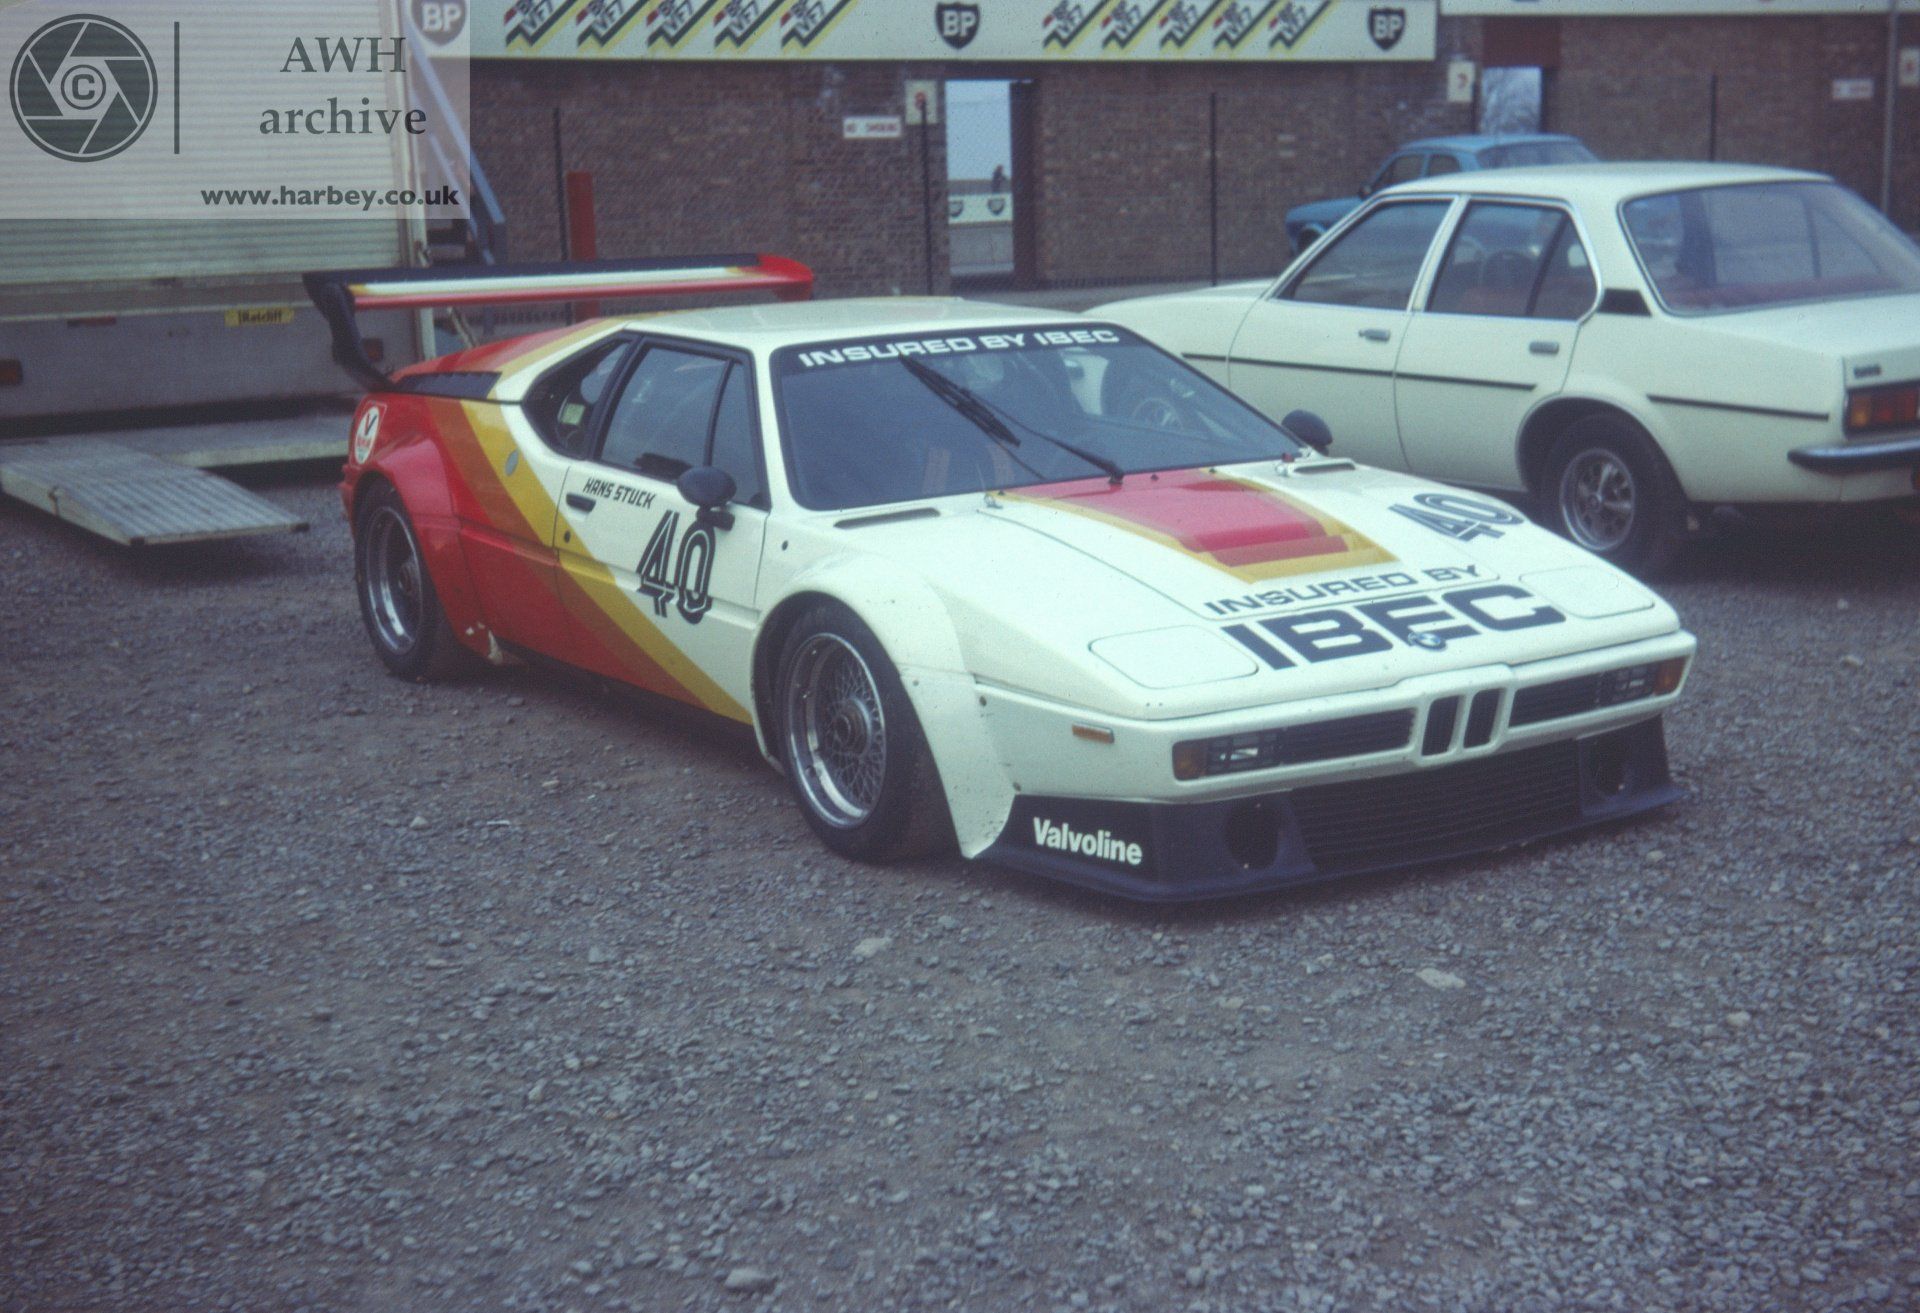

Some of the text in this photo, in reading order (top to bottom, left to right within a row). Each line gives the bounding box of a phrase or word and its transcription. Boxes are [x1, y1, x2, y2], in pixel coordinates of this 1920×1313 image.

[420, 3, 462, 33] BP
[941, 12, 976, 37] BP
[1373, 15, 1404, 39] BP
[798, 328, 1120, 368] INSURED BY IBEC
[583, 477, 656, 507] HANS STUCK
[1389, 493, 1525, 544] 40
[636, 511, 717, 625] 40
[1204, 564, 1481, 616] INSURED BY
[1221, 584, 1566, 671] IBEC
[1033, 816, 1144, 867] Valvoline
